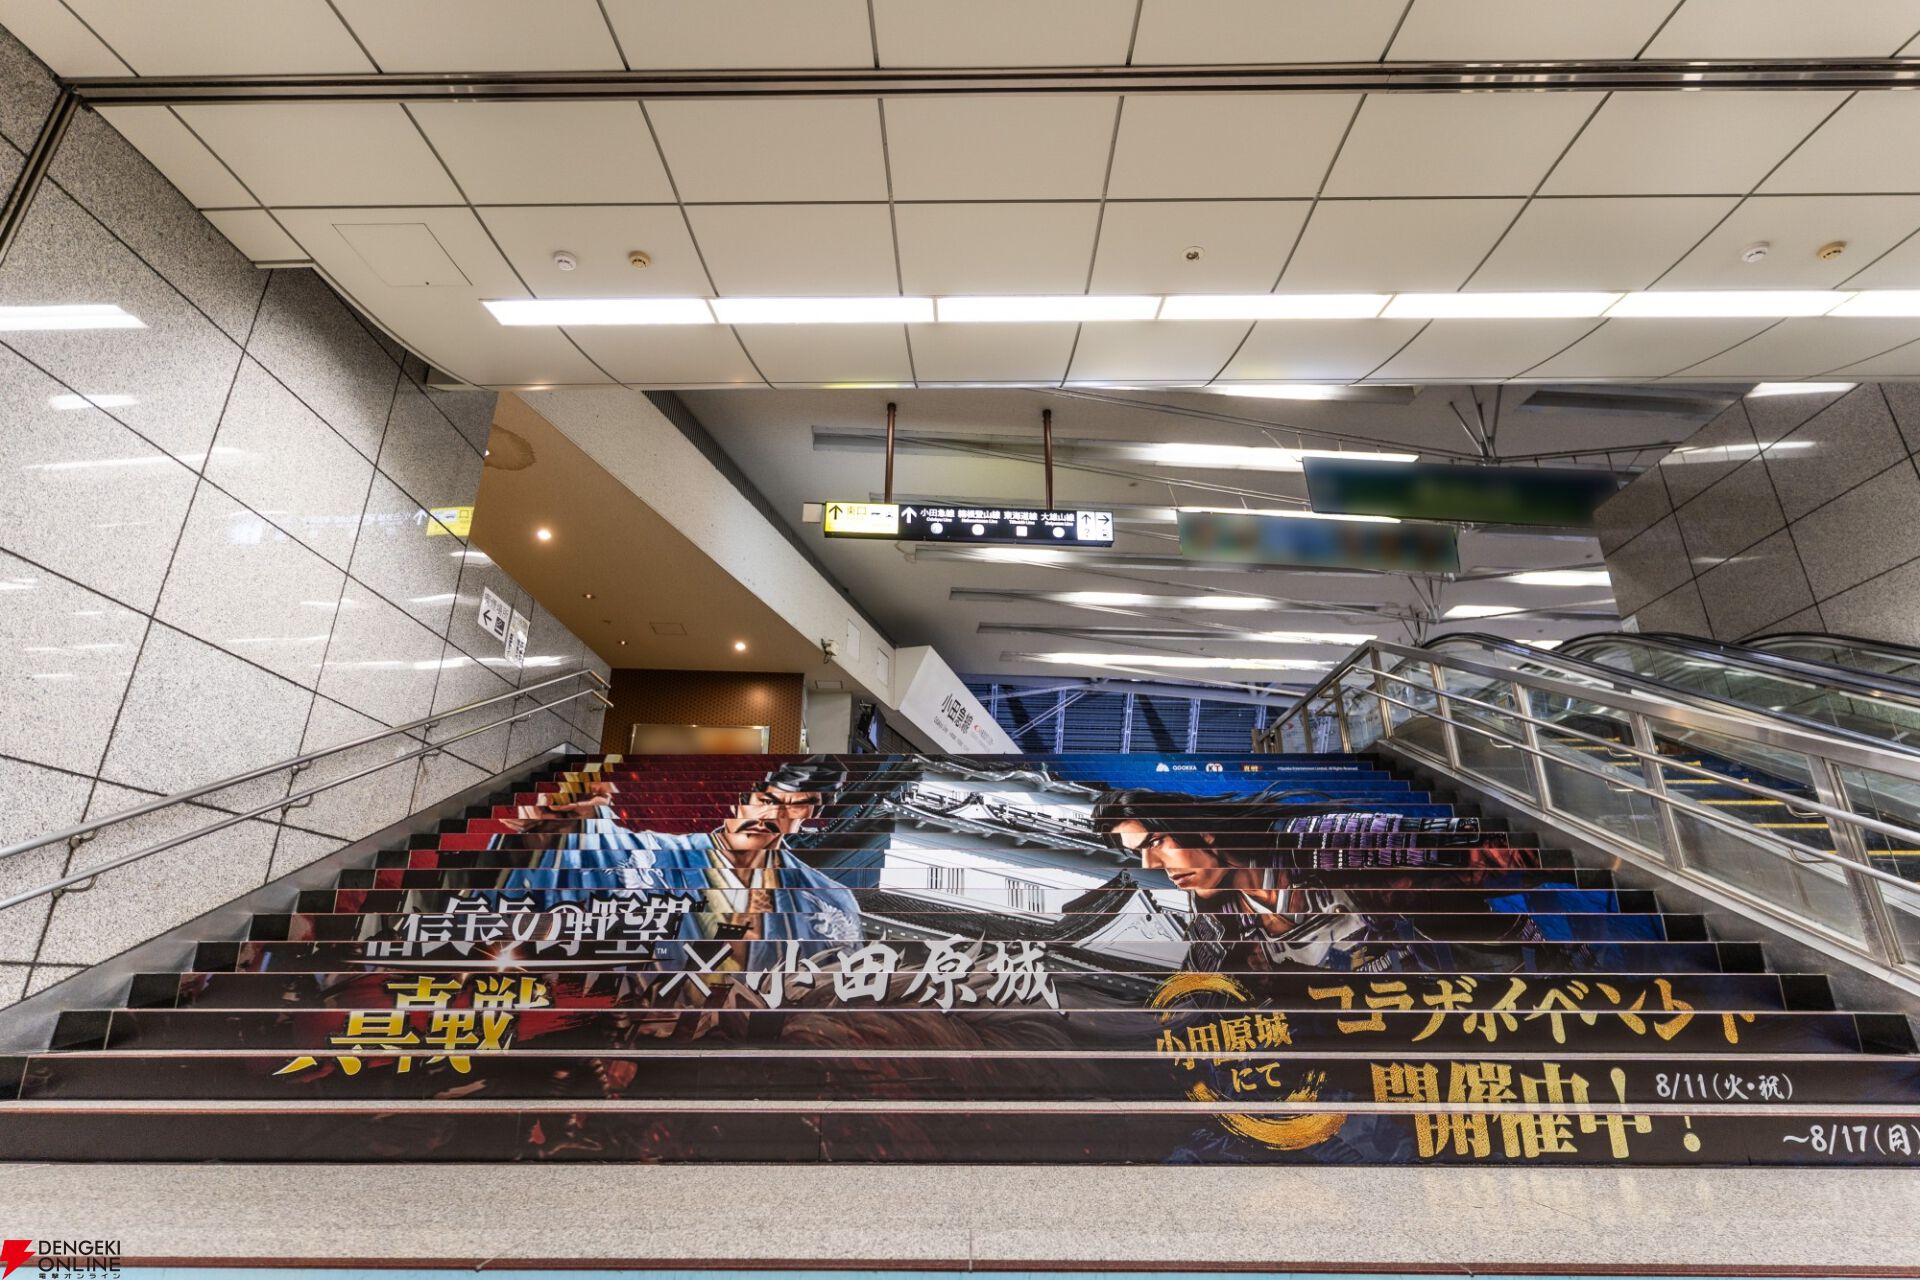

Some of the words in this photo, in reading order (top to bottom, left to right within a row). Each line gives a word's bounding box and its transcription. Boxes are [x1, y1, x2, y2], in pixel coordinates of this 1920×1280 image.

[920, 508, 955, 518] 小田急線
[1003, 510, 1038, 521] 東海道線
[365, 896, 692, 957] 信長の野望
[746, 934, 1062, 1011] 小田原城
[1307, 975, 1756, 1045] コラボイベント
[1156, 1012, 1293, 1070] 小田原城
[1231, 1062, 1282, 1093] にて
